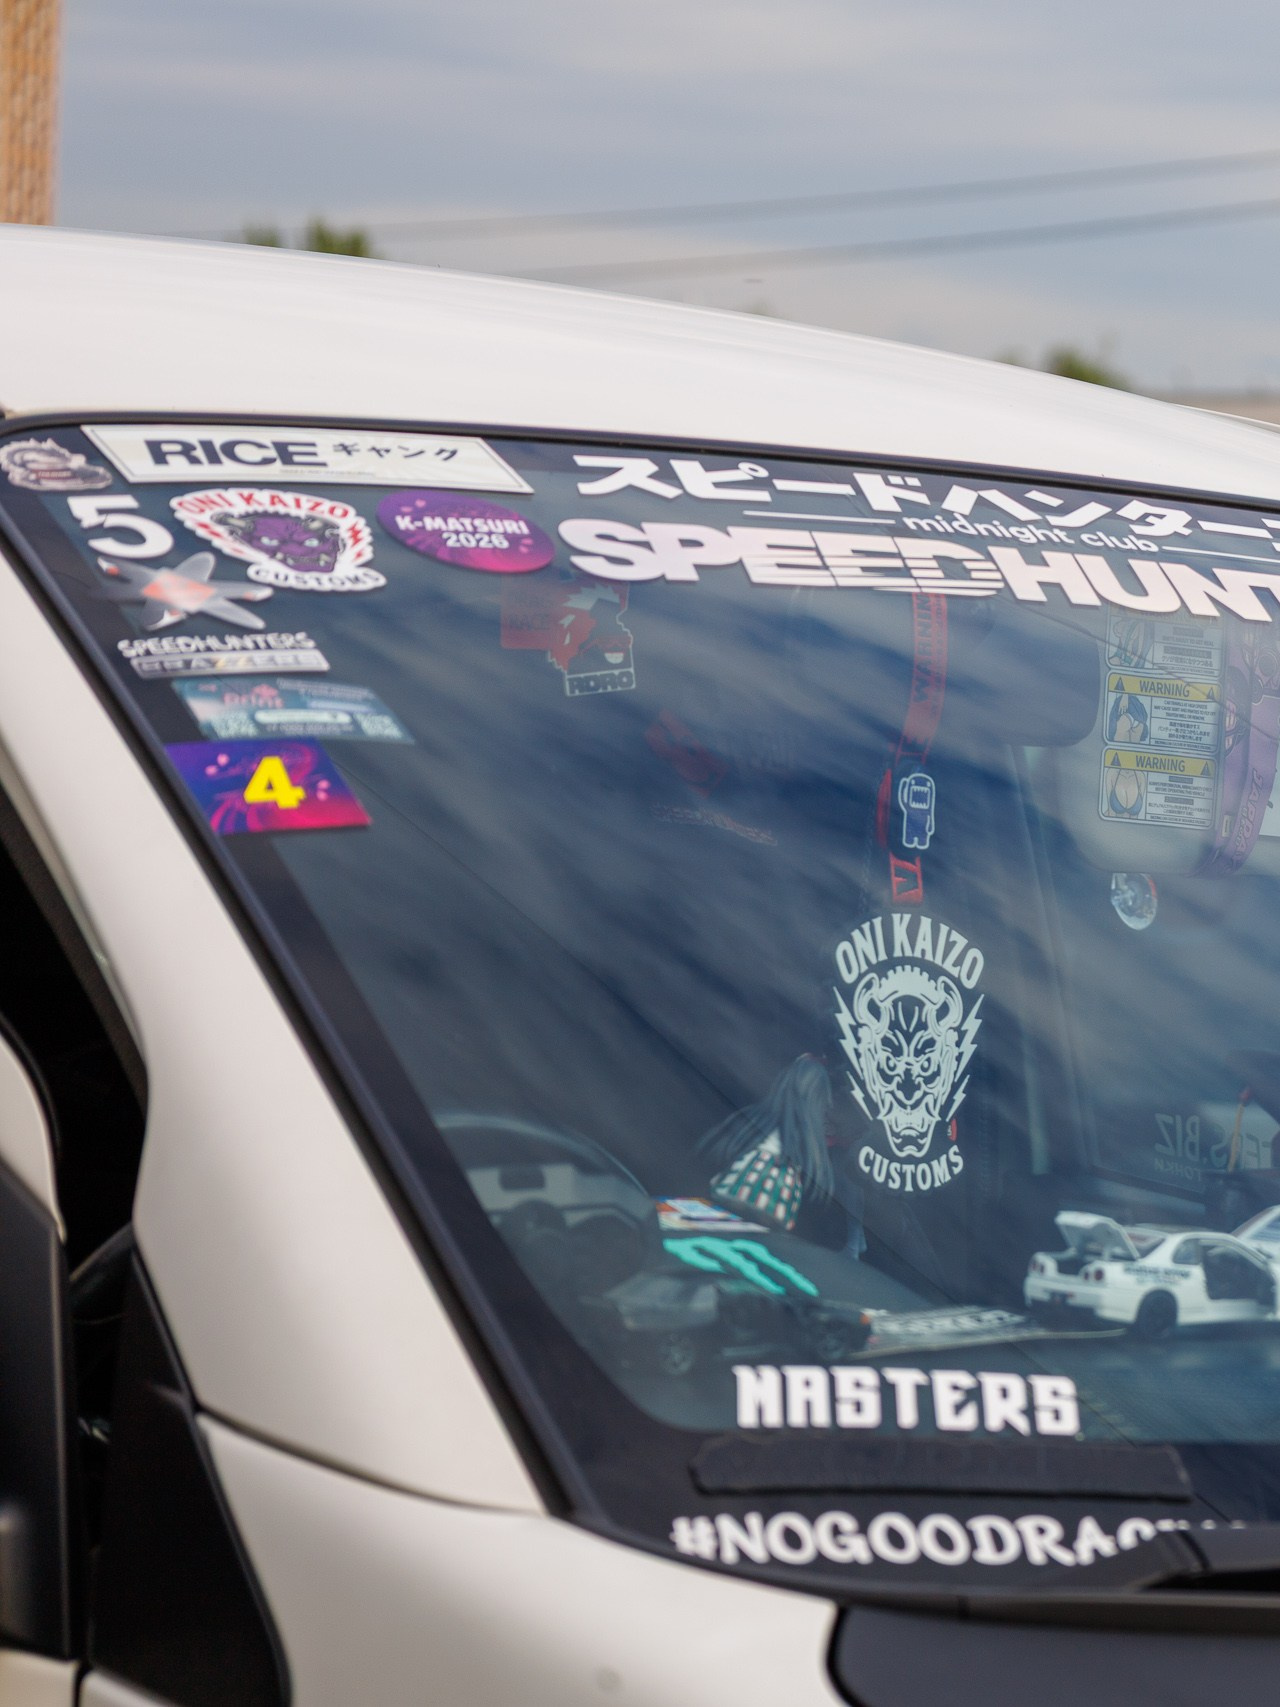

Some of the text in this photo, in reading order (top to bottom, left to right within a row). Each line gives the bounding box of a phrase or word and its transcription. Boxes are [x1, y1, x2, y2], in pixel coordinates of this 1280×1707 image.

[144, 439, 328, 467] RICE
[178, 492, 349, 519] ONI KAIZO
[67, 494, 174, 558] 5
[395, 515, 531, 535] K-MATSURI
[903, 513, 1160, 554] midnight club
[441, 532, 510, 549] 2026
[255, 568, 381, 587] CUSTOMS
[117, 631, 316, 658] SPEEDHUNTERS
[1139, 679, 1190, 698] WARNING
[1135, 754, 1186, 773] WARNING
[244, 756, 305, 808] 4
[834, 913, 986, 990] ONI KAIZO
[858, 1144, 964, 1192] CUSTOMS
[731, 1364, 1082, 1436] MASTERS
